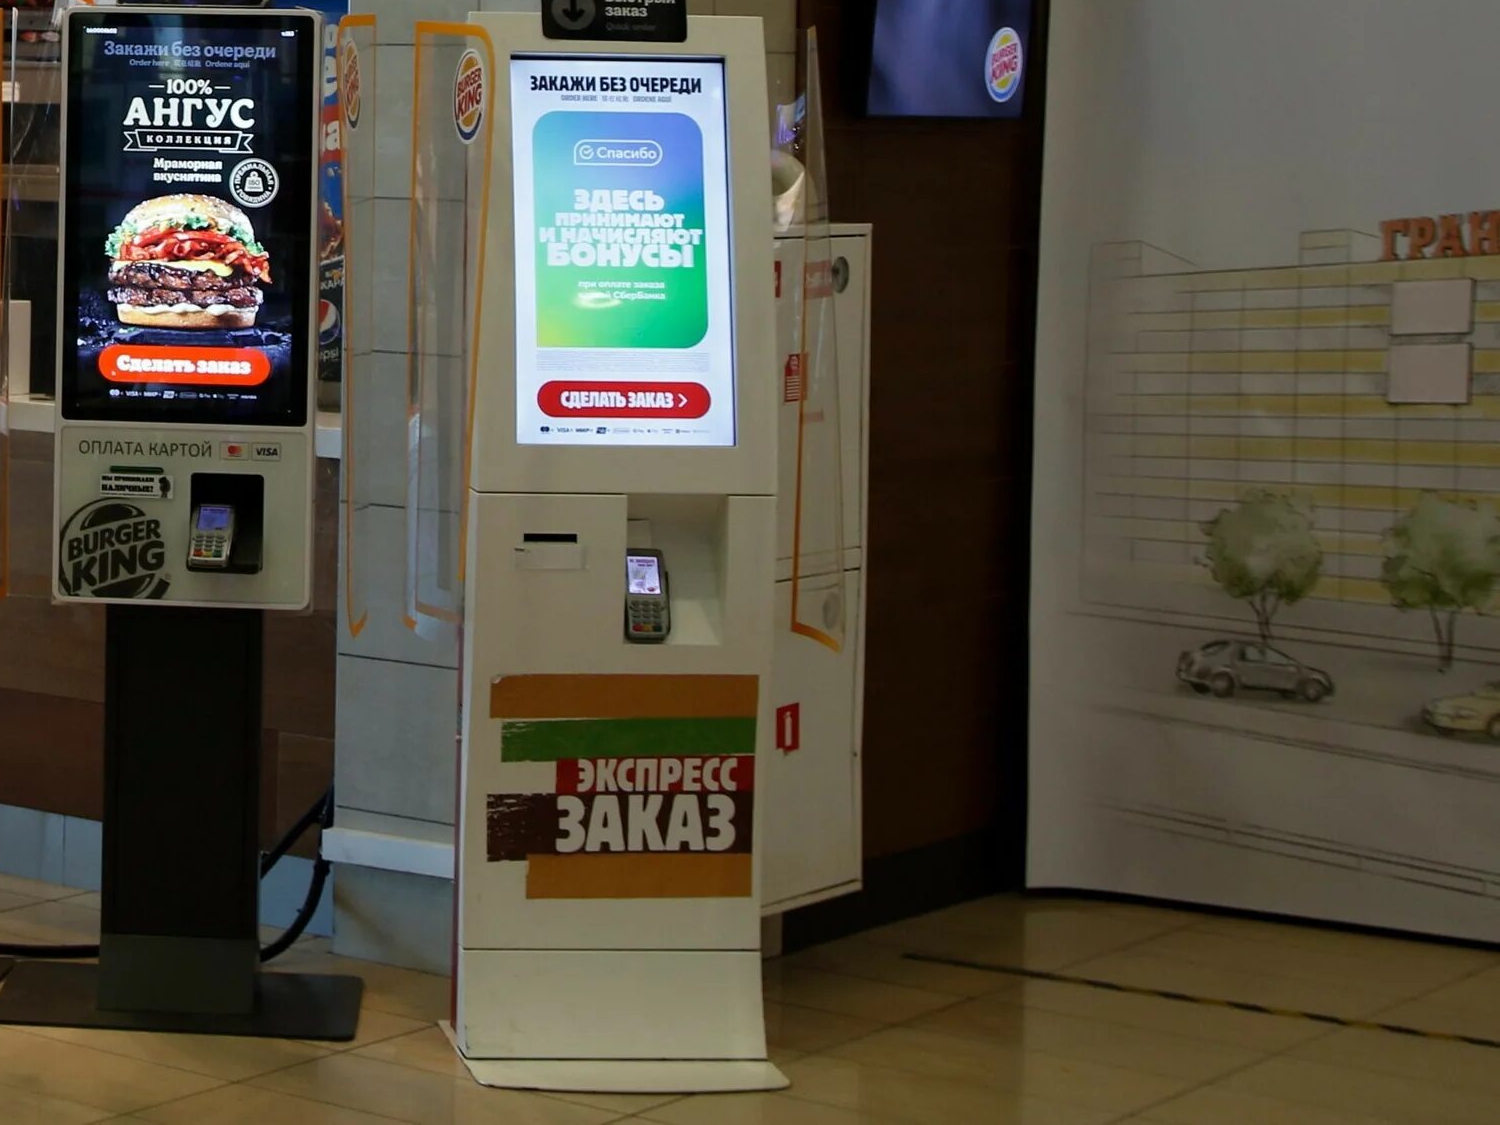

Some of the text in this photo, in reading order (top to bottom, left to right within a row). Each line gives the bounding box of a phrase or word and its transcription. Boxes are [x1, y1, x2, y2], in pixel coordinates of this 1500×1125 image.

[605, 5, 649, 17] заказ
[103, 40, 277, 61] Закажи без очереди
[992, 55, 1018, 81] KING
[166, 79, 213, 95] 100%
[457, 66, 483, 97] BURGER
[530, 75, 702, 94] ЗАКАЖИ БЕЗ ОЧЕРЕДИ
[457, 83, 483, 117] KING
[123, 97, 255, 129] АНГУС
[146, 134, 232, 145] КОЛЛЕКЦИЯ
[596, 146, 658, 160] Спасибо
[153, 157, 223, 171] Мраморная
[153, 173, 222, 183] вкуснятина
[574, 189, 665, 212] ЗДЕСЬ
[555, 213, 685, 228] ПРИНИМАЮТ
[539, 227, 703, 245] И НАЧИСЛЯЮТ
[547, 243, 694, 268] БОНУСЫ
[578, 280, 666, 289] при оплате заказа
[116, 354, 252, 375] Сделать заказ
[560, 391, 674, 409] СДЕЛАТЬ ЗАКАЗ
[78, 439, 213, 458] ОПЛАТА КАРТОЙ
[255, 447, 278, 457] VISA
[67, 518, 161, 562] BURGER
[71, 539, 165, 593] KING
[576, 757, 738, 793] ЭКСПРЕСС
[555, 793, 737, 853] ЗАКАЗ
